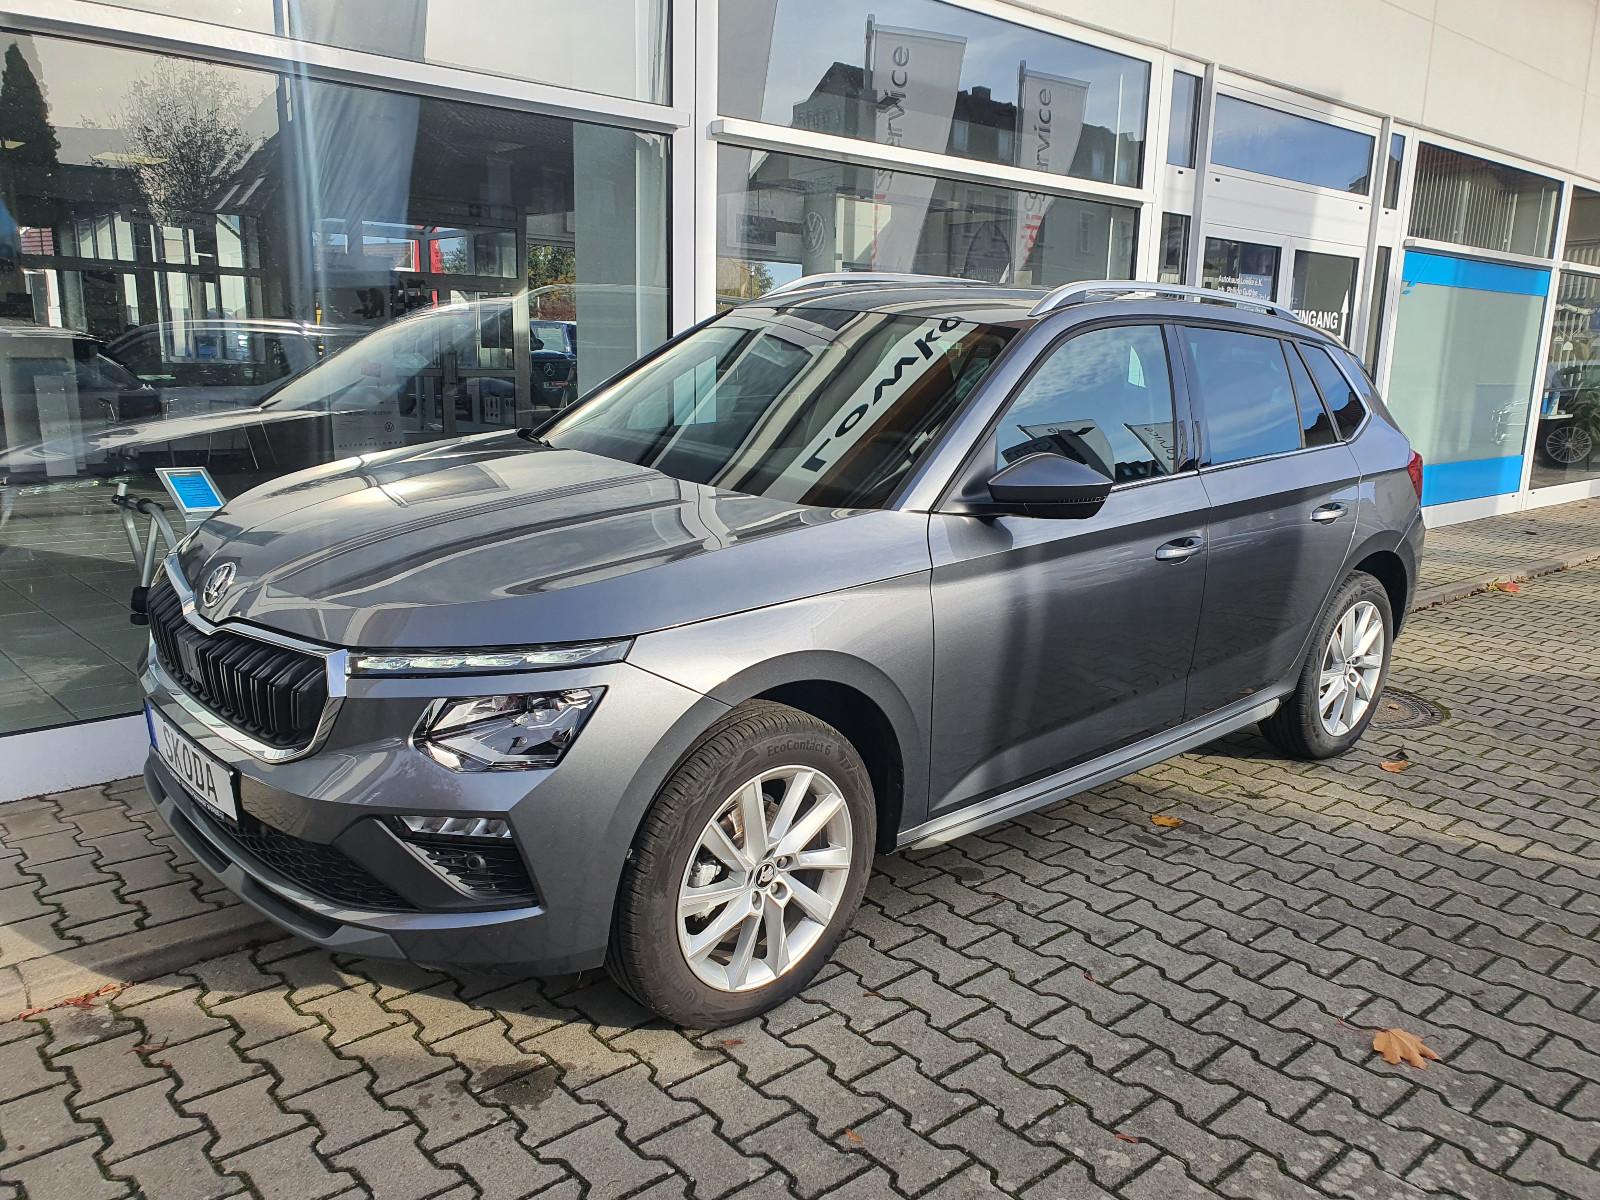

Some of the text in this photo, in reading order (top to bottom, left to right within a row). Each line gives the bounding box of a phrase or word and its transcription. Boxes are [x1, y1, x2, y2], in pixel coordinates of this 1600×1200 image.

[163, 726, 218, 803] SKODA
[766, 739, 832, 757] EcoContact 6
